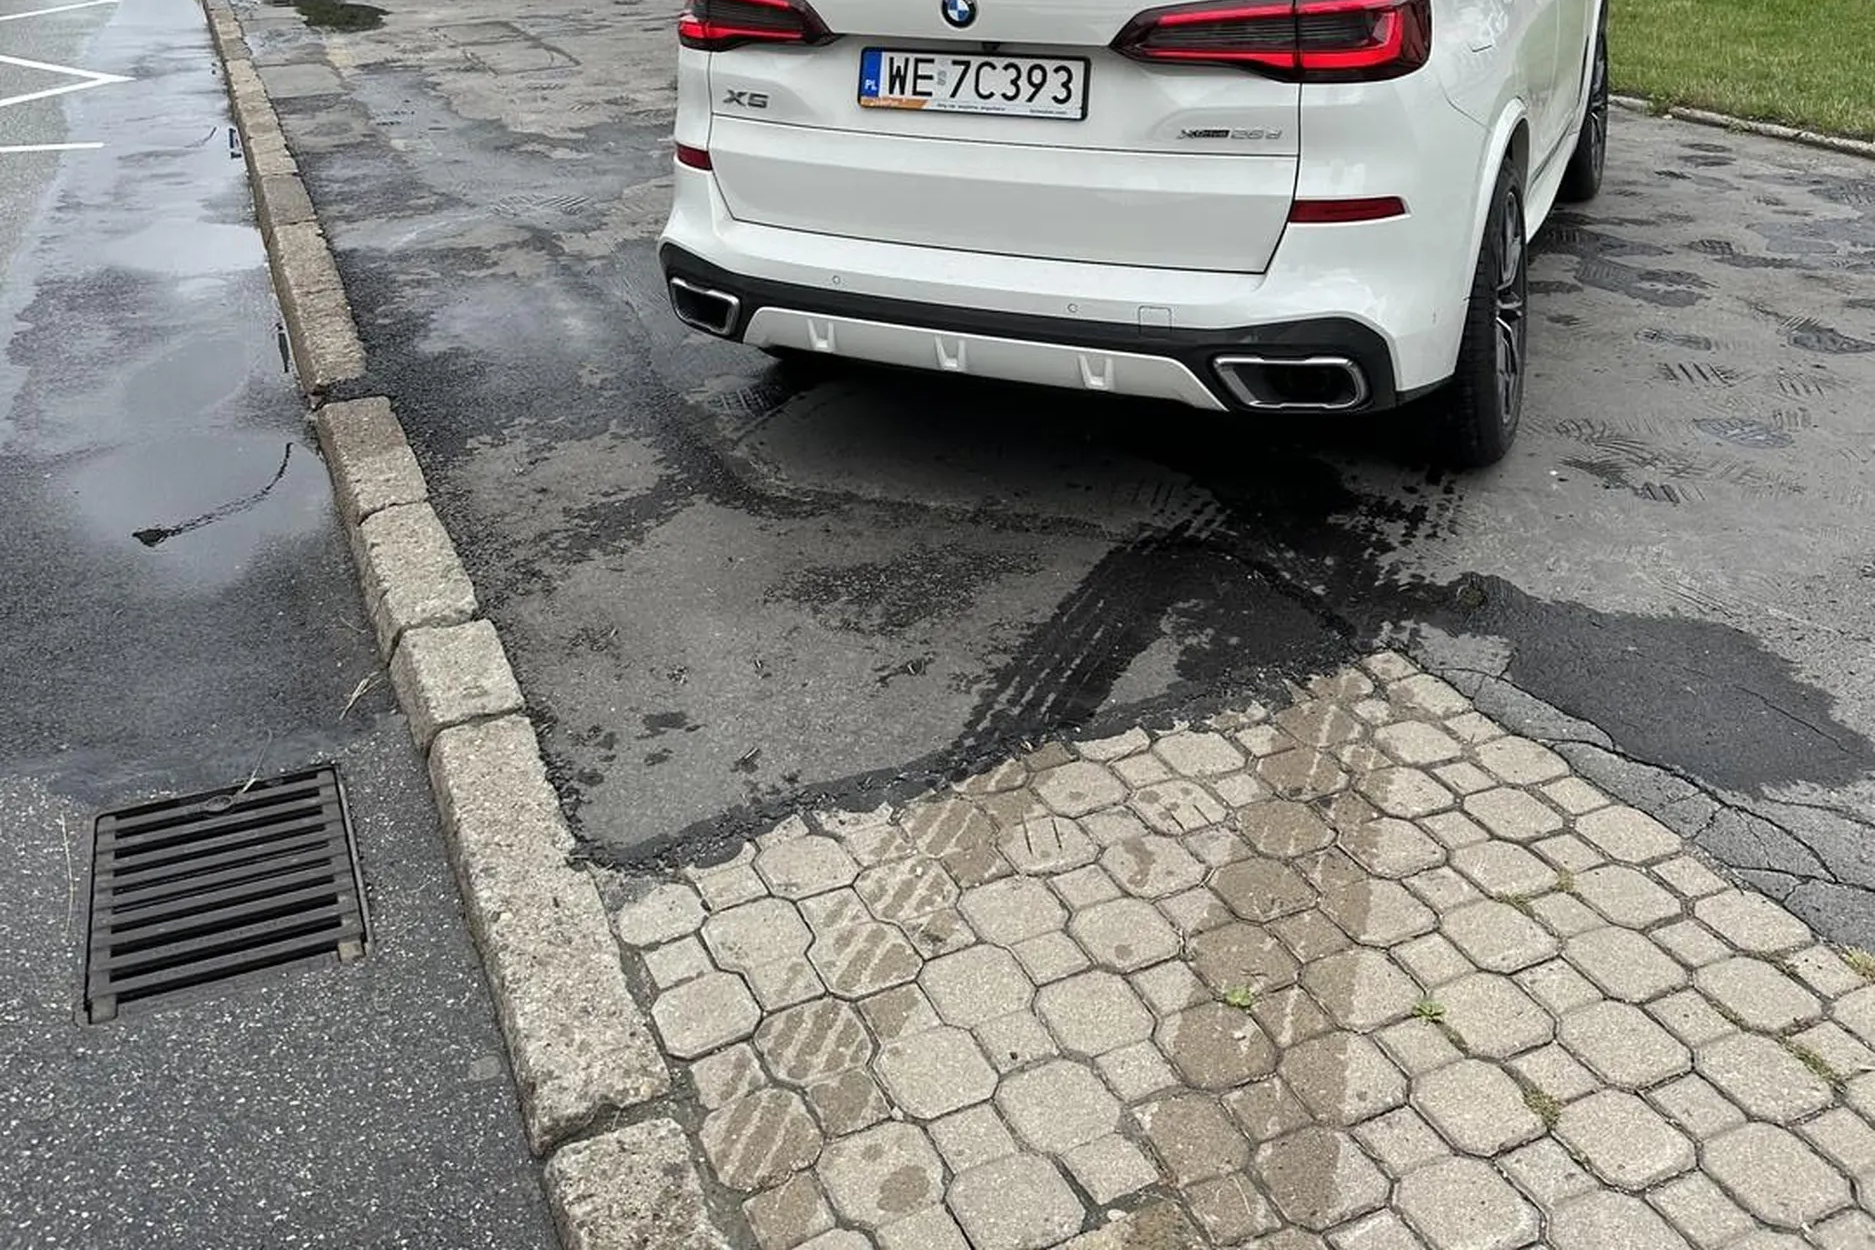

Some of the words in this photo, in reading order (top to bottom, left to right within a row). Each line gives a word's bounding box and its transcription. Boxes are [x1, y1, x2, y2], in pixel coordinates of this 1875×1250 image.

[864, 78, 878, 91] PL
[888, 56, 935, 97] WE
[949, 59, 1074, 106] 7C393
[722, 88, 770, 109] X5
